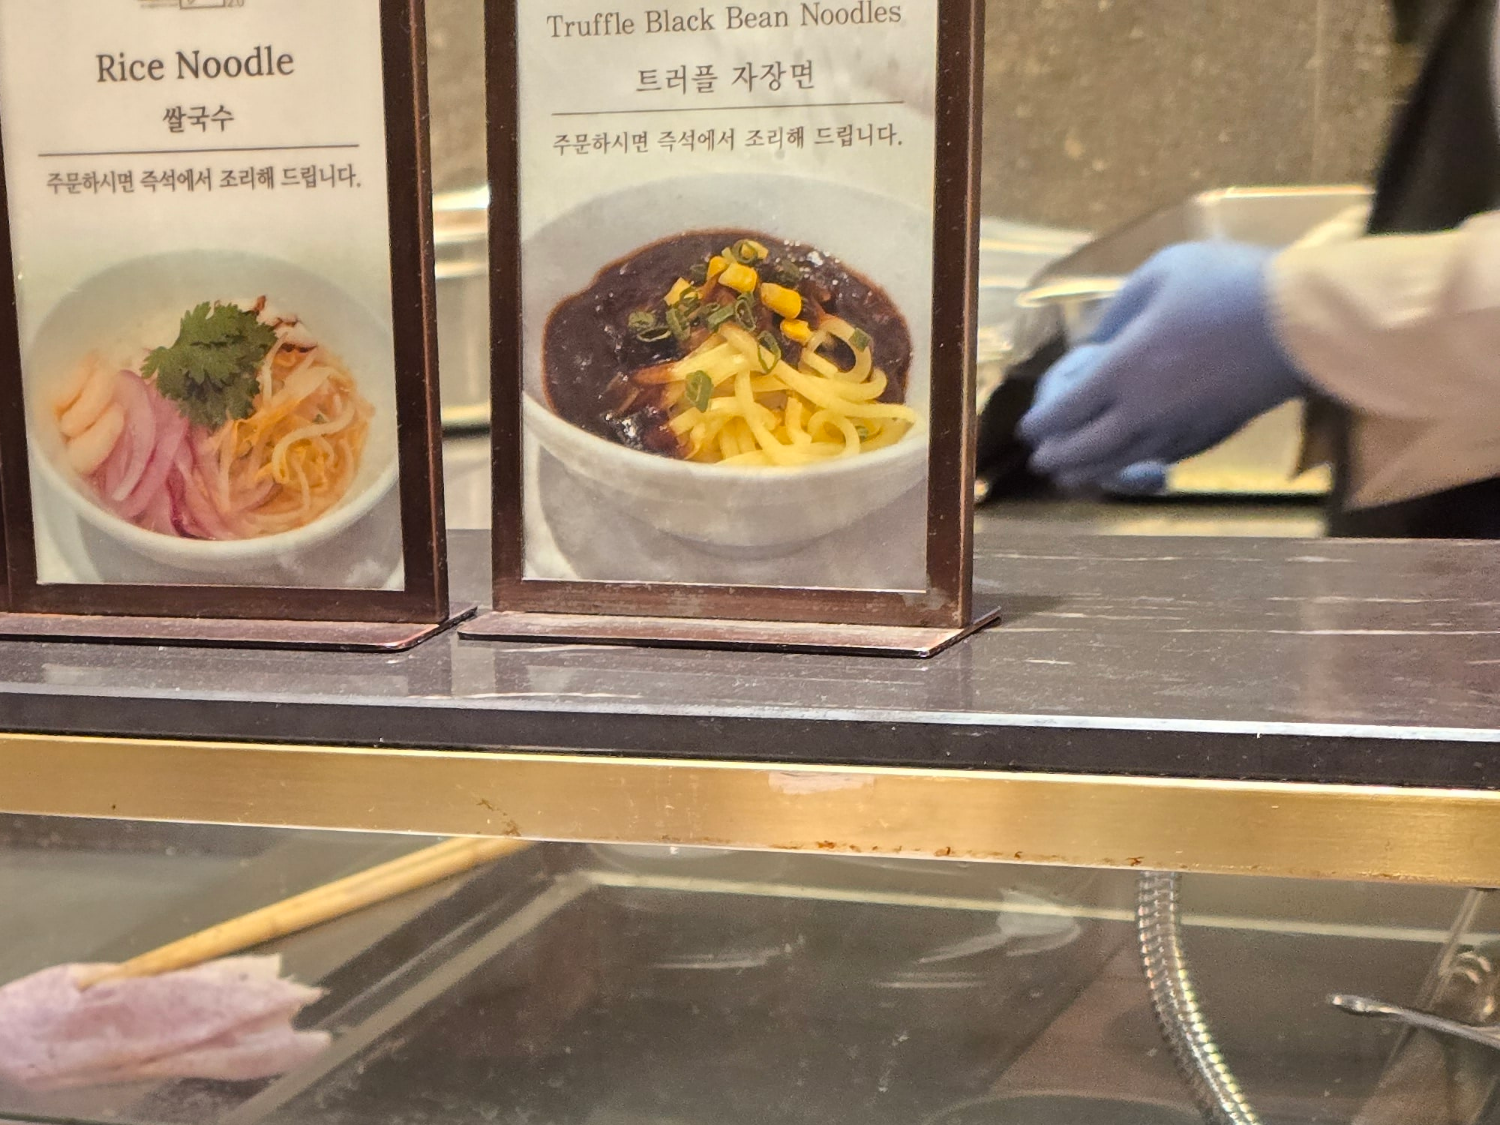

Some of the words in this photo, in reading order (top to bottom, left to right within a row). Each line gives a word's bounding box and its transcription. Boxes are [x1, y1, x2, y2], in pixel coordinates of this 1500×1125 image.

[546, 12, 634, 38] Truffle
[645, 8, 715, 34] Black
[726, 3, 789, 30] Bean
[801, 0, 902, 27] Noodles
[96, 52, 165, 83] Rice
[175, 46, 295, 80] Noodle
[636, 64, 719, 94] 트러플
[731, 61, 814, 92] 자장면
[162, 105, 235, 133] 쌀국수
[552, 132, 649, 156] 주문하시면
[657, 129, 736, 153] 즉석에서
[744, 127, 804, 150] 조리해
[814, 123, 903, 148] 드립니다.
[46, 170, 134, 195] 주문하시면
[140, 168, 212, 193] 즉석에서
[219, 166, 275, 191] 조리해
[280, 164, 362, 189] 드립니다.
